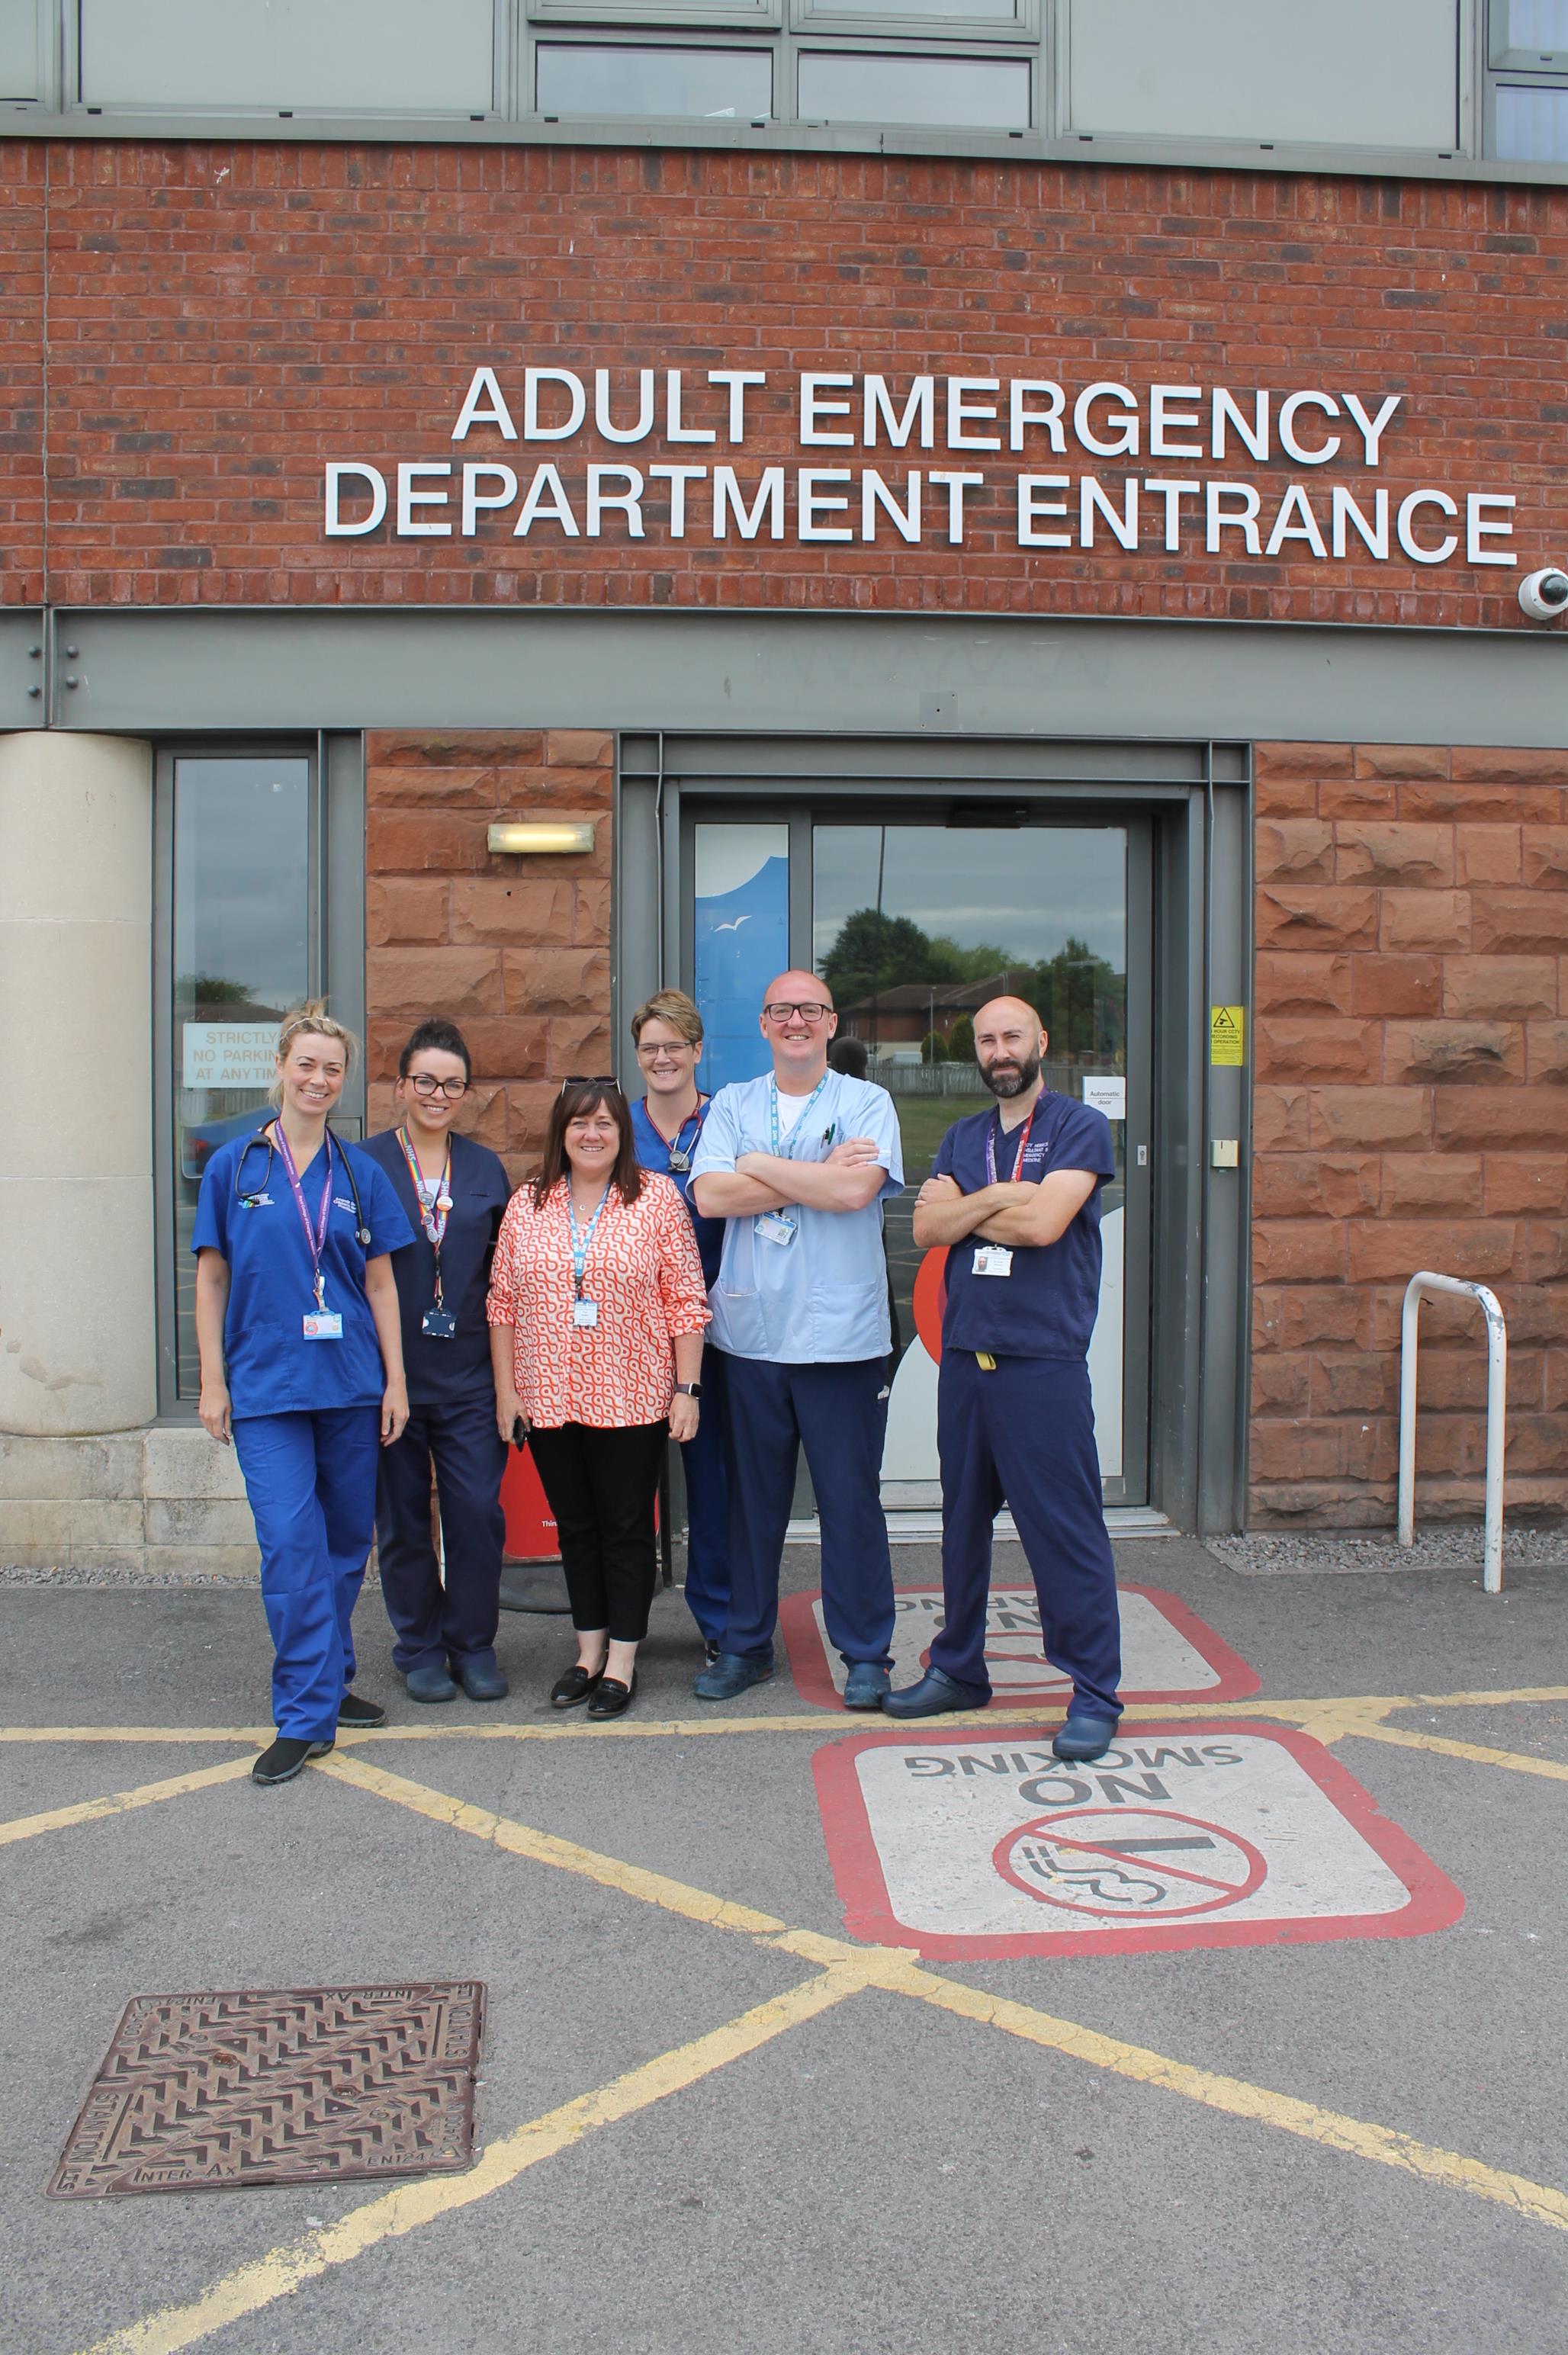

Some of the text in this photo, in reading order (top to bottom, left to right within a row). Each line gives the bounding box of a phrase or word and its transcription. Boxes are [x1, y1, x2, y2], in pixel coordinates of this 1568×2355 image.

[451, 368, 1402, 467] ADULT EMERGENCY
[325, 462, 1518, 566] DEPARTMENT ENTRANCE
[207, 1031, 278, 1045] STRICTLY
[193, 1049, 275, 1062] NO PARKIN
[196, 1068, 276, 1081] AT ANYTIM
[404, 1145, 416, 1161] NHS
[441, 1181, 449, 1197] NHS
[904, 1745, 1243, 1778] SMOKING
[1018, 1773, 1172, 1806] NO
[445, 2003, 472, 2058] STANTON
[69, 2093, 119, 2163] STANTON
[367, 2152, 426, 2167] EN124
